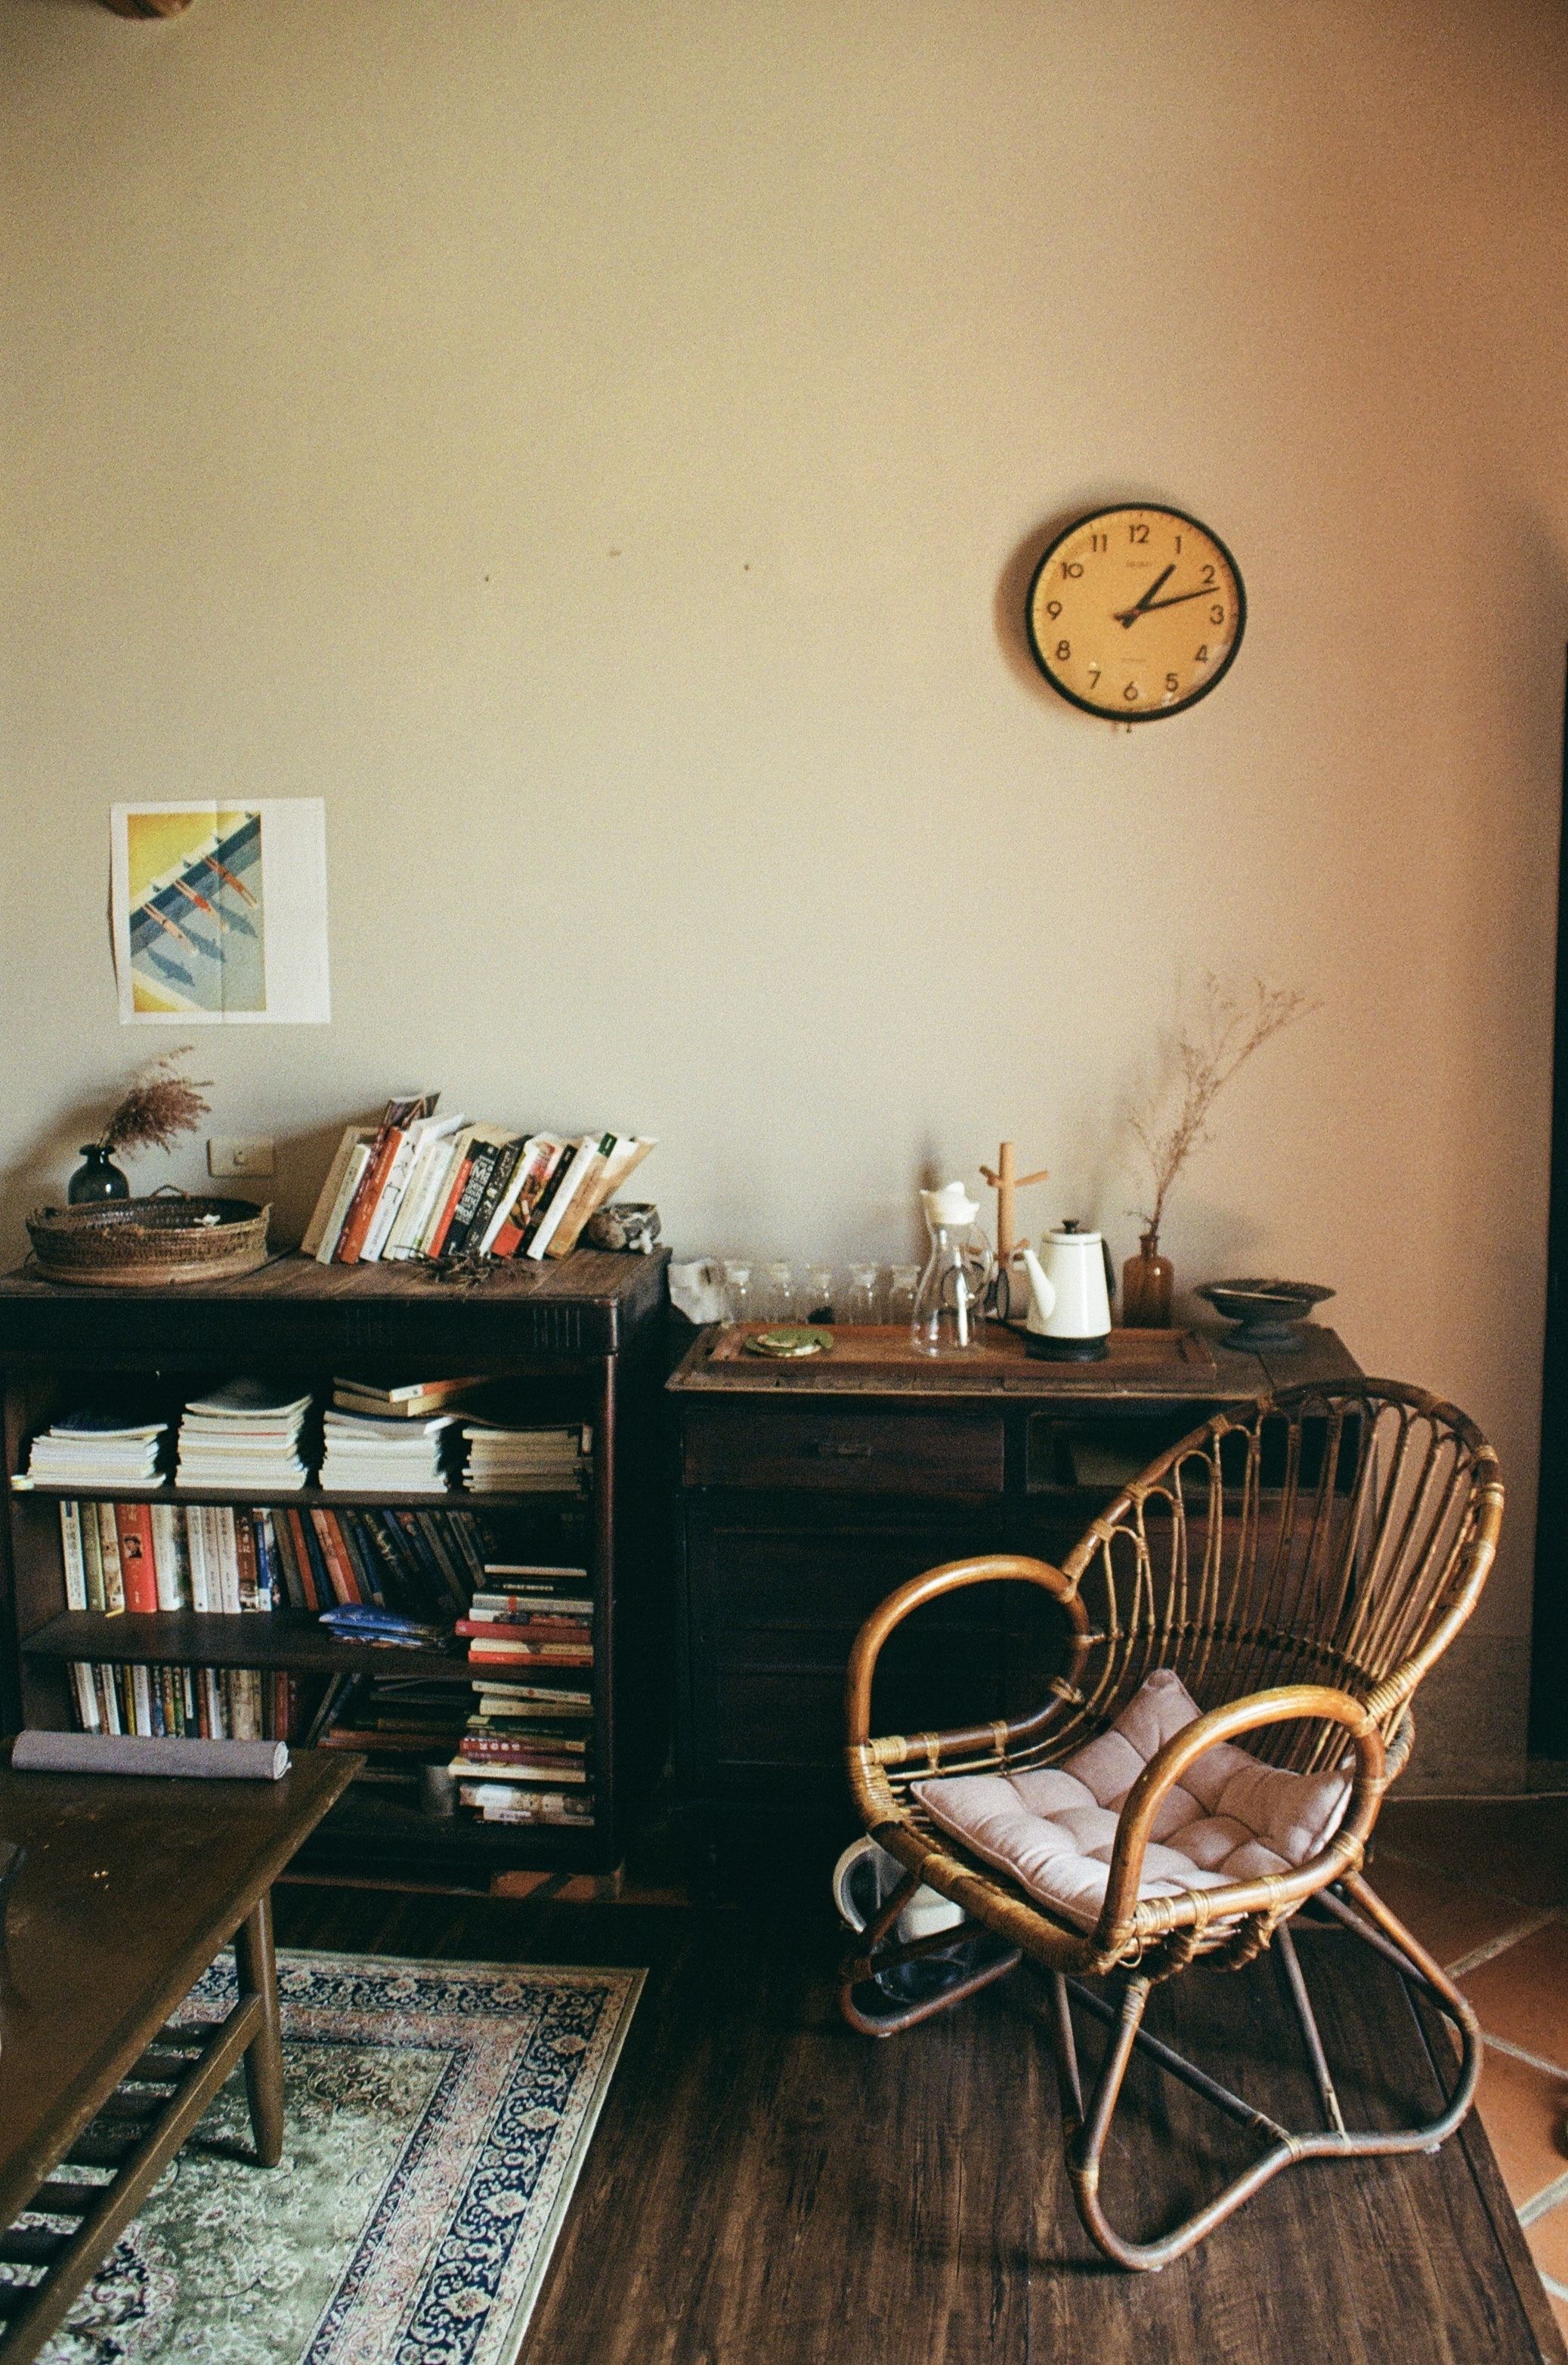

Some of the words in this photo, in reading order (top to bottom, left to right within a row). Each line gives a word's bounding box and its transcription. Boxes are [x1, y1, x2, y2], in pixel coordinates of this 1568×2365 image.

[1090, 533, 1108, 552] 11
[1129, 524, 1150, 544] 12
[1174, 535, 1182, 554] 1
[1061, 561, 1084, 580] 10
[1202, 565, 1215, 584] 2
[1047, 601, 1062, 620] 9
[1210, 604, 1224, 625] 3
[1056, 640, 1071, 661] 8
[1195, 644, 1208, 663] 4
[1088, 670, 1101, 689] 7
[1166, 672, 1178, 692] 5
[1124, 681, 1138, 701] 6
